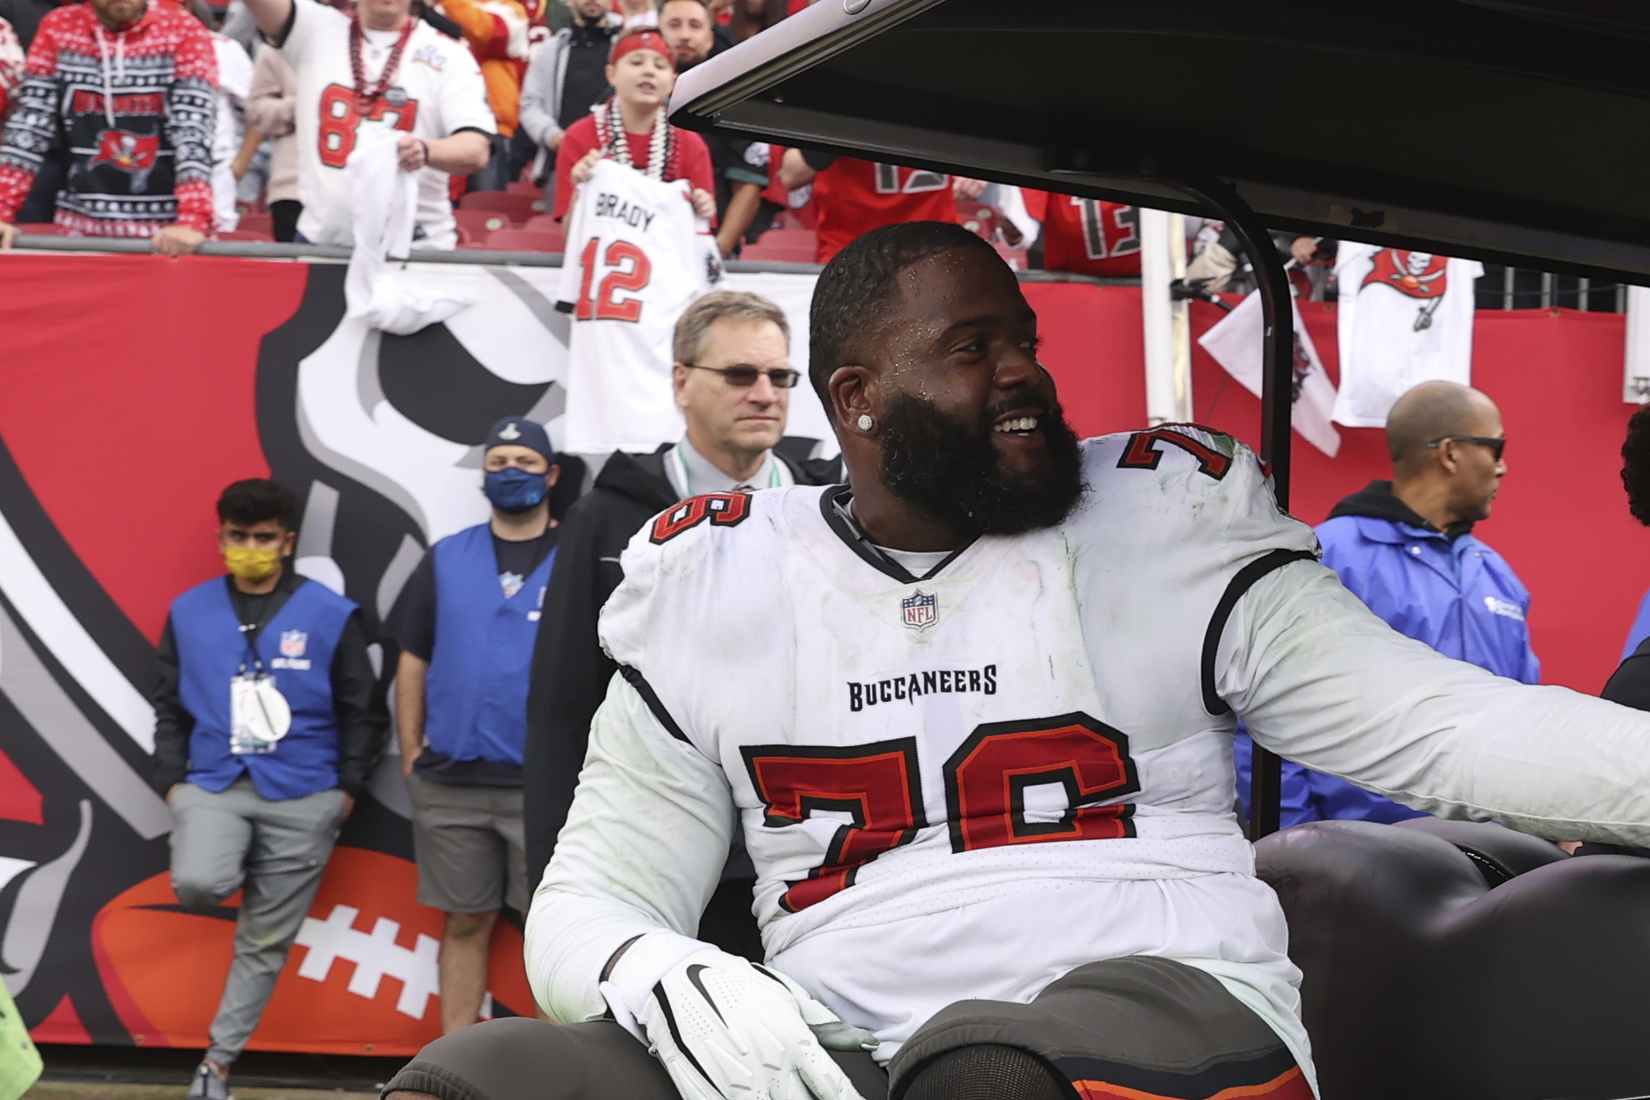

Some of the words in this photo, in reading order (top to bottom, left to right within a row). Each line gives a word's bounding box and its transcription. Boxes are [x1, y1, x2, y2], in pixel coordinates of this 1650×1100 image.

[595, 193, 655, 233] BRADY
[574, 236, 653, 323] 12
[906, 606, 933, 624] NFL
[846, 664, 997, 712] BUCCANEERS
[739, 711, 1141, 913] 76
